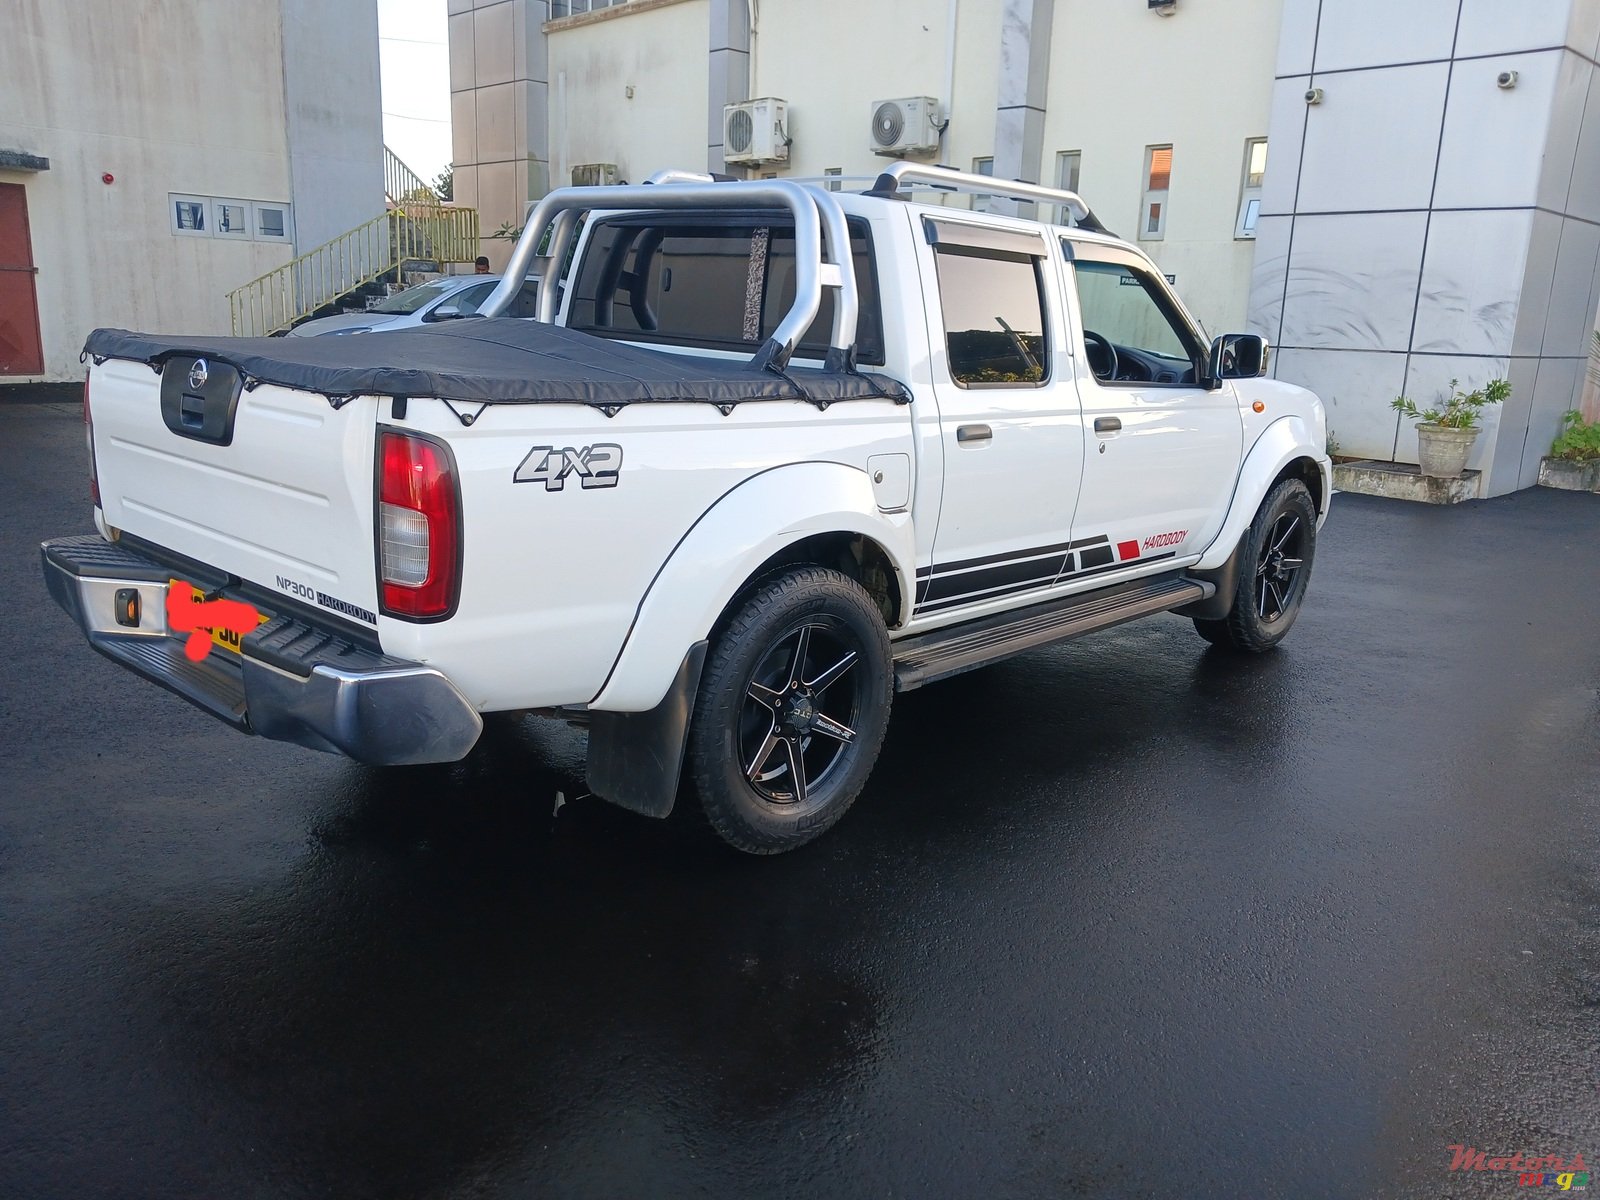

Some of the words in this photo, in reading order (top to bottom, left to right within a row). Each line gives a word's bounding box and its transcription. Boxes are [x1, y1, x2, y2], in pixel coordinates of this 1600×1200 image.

[1142, 530, 1189, 551] HARDBODY
[275, 575, 315, 601] NP300
[317, 591, 376, 625] HARDBODY
